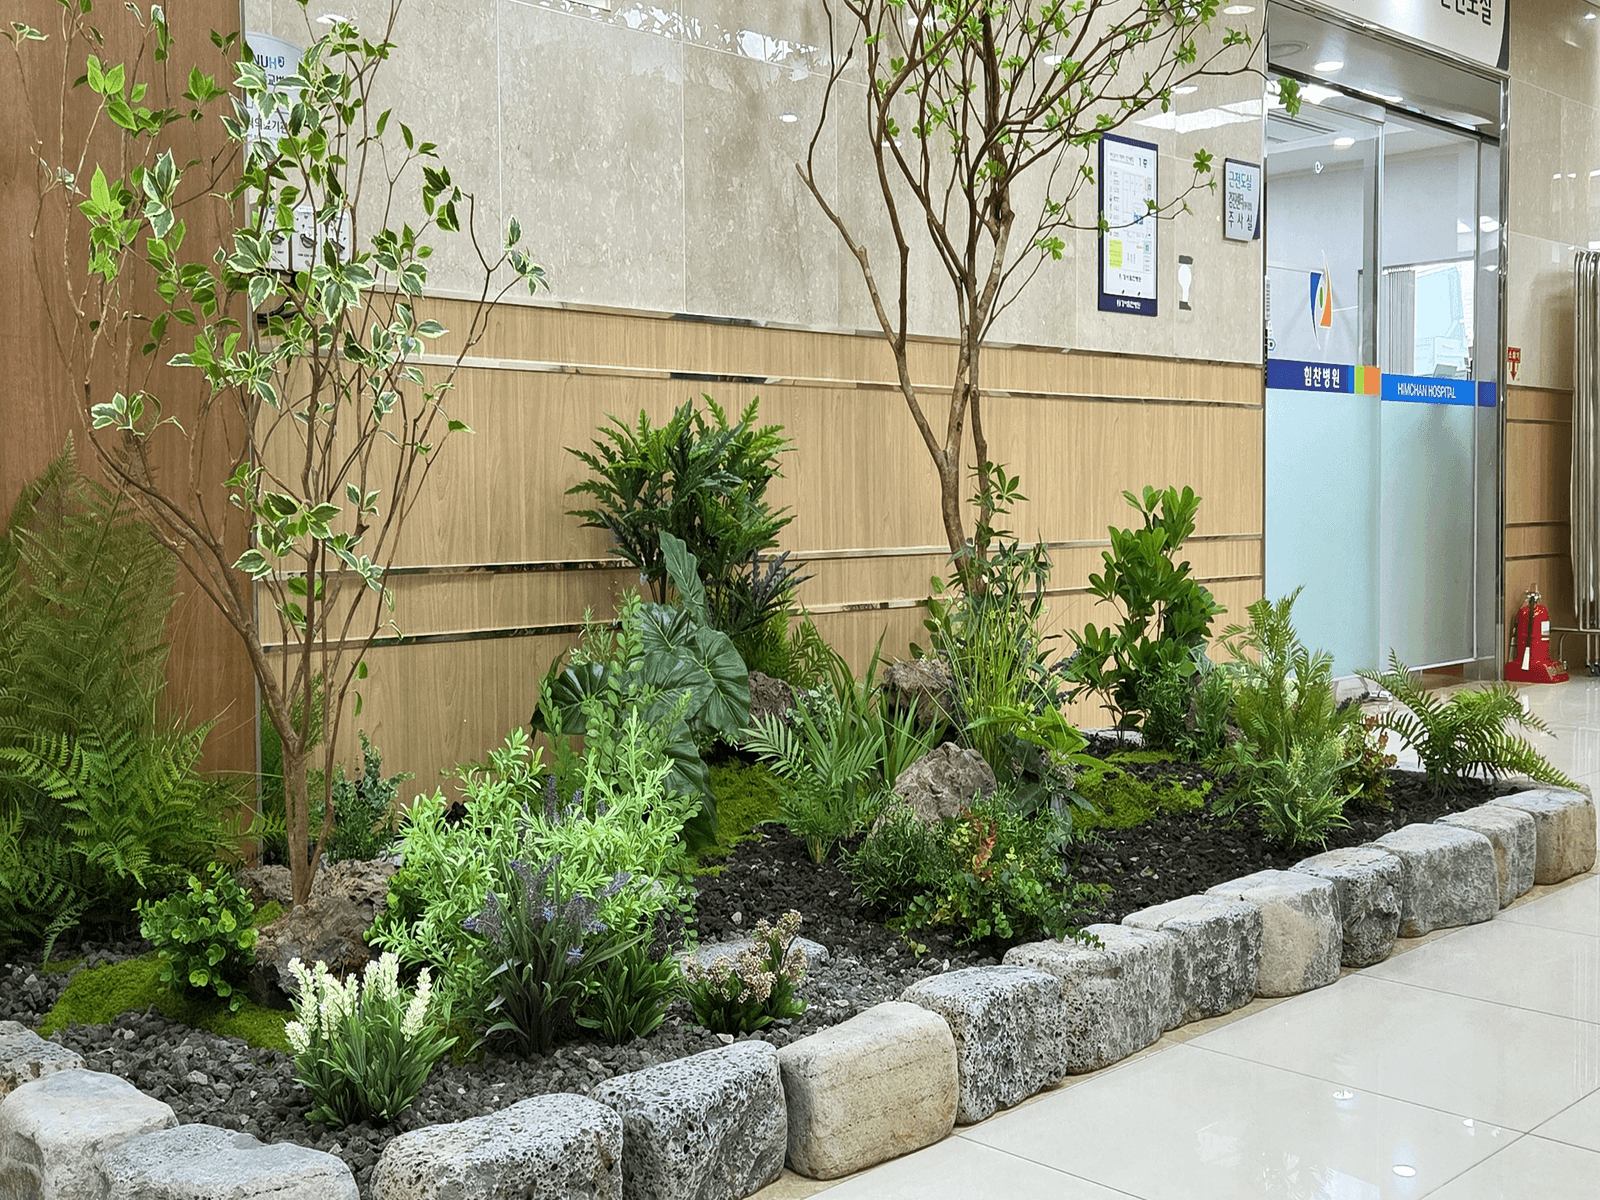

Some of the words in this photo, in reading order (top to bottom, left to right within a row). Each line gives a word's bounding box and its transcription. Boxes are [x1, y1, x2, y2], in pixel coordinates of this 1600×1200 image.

[1228, 170, 1252, 191] 근전도실
[1228, 211, 1253, 231] 주사실
[1303, 366, 1340, 388] 힘찬병원
[1397, 383, 1428, 397] HIMCHAN
[1429, 385, 1457, 399] HOSPITAL
